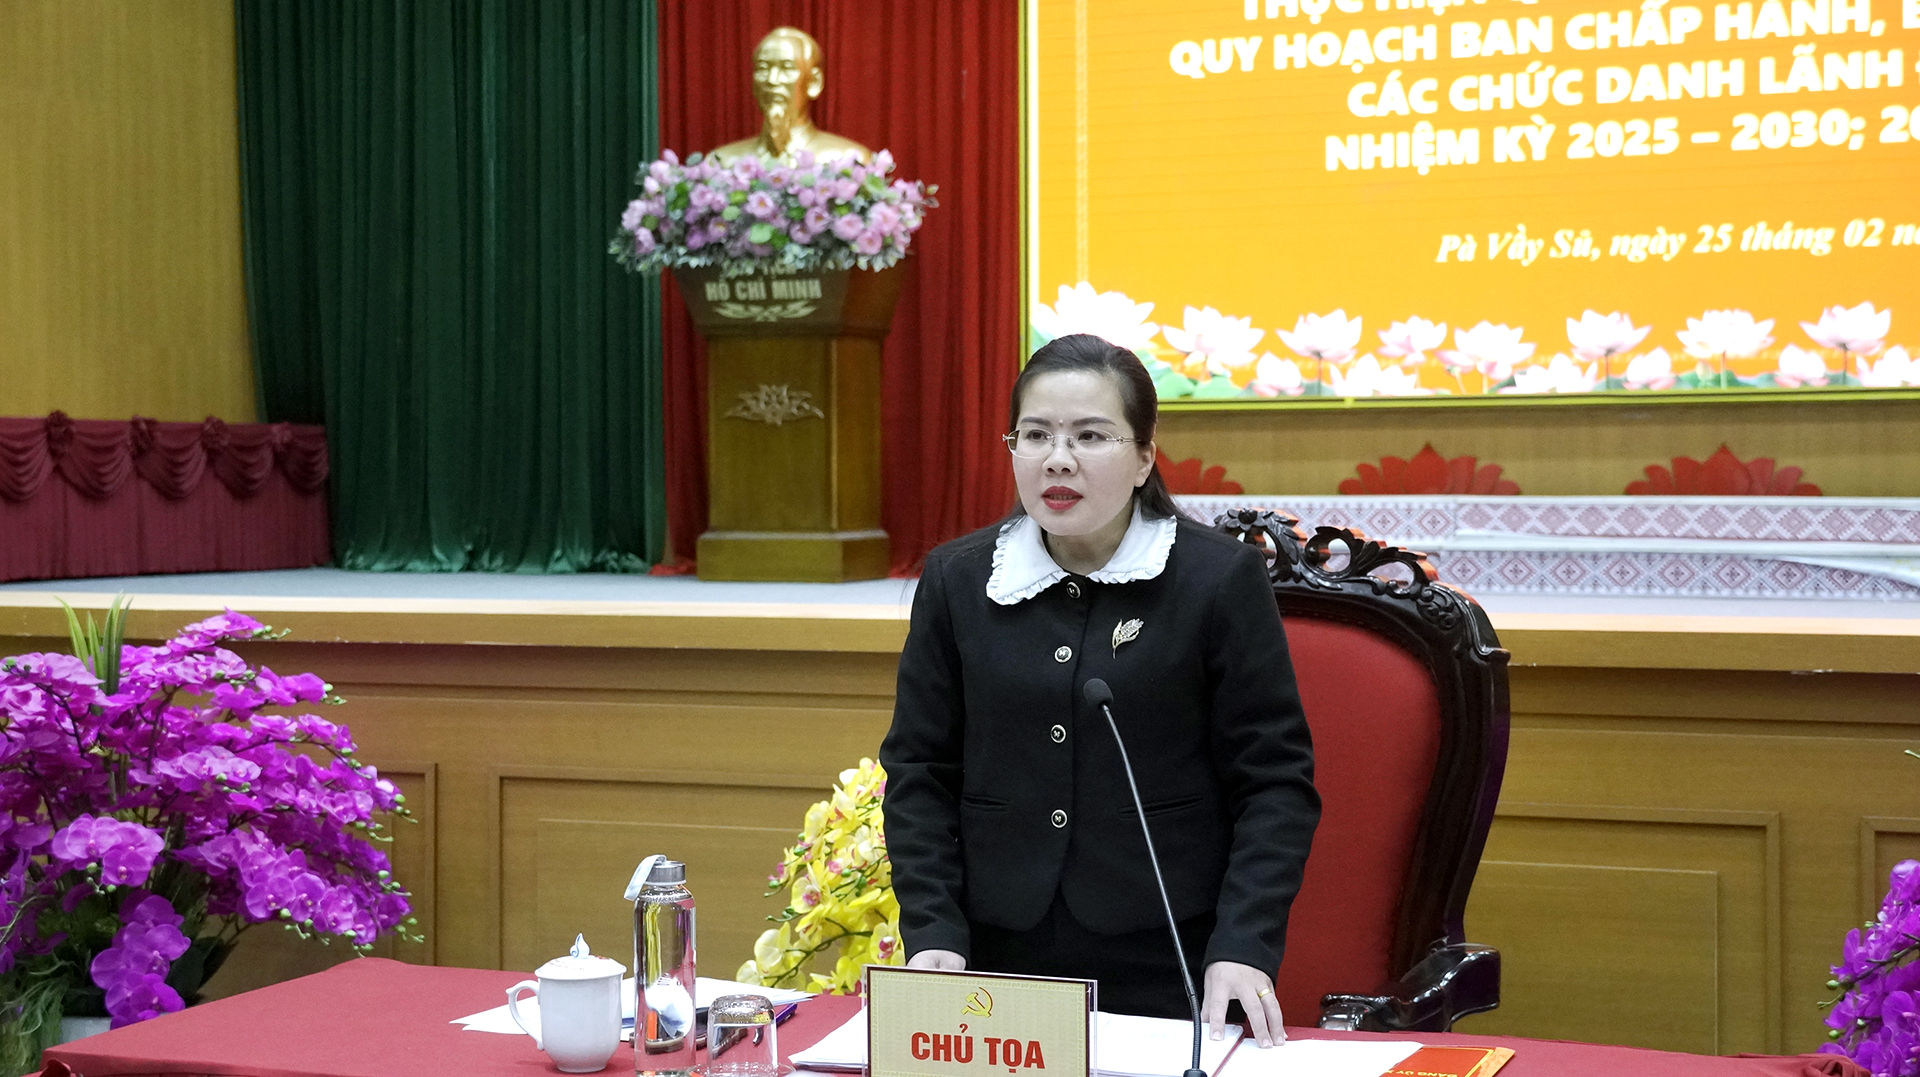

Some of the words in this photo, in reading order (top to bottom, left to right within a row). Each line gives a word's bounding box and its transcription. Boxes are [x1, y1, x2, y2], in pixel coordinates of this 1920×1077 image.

[1168, 36, 1263, 79] QUY
[1273, 24, 1438, 74] HOẠCH
[1450, 16, 1553, 59] BAN
[1564, 0, 1702, 50] CHẤP
[1346, 70, 1438, 118] CÁC
[1448, 60, 1583, 112] CHỨC
[1595, 59, 1745, 104] DANH
[1758, 42, 1904, 94] LÃNH
[1325, 120, 1480, 175] NHIỆM
[1492, 114, 1556, 163] KỲ
[1566, 117, 1680, 160] 2025
[1731, 108, 1866, 150] 2030;
[1435, 233, 1478, 263] Pà
[1609, 226, 1687, 263] ngày
[1692, 223, 1734, 253] 25
[1740, 220, 1836, 256] tháng
[1843, 217, 1885, 247] 02
[771, 279, 822, 300] MINH
[911, 1023, 974, 1064] CHỦ
[983, 1036, 1046, 1074] TỌA
